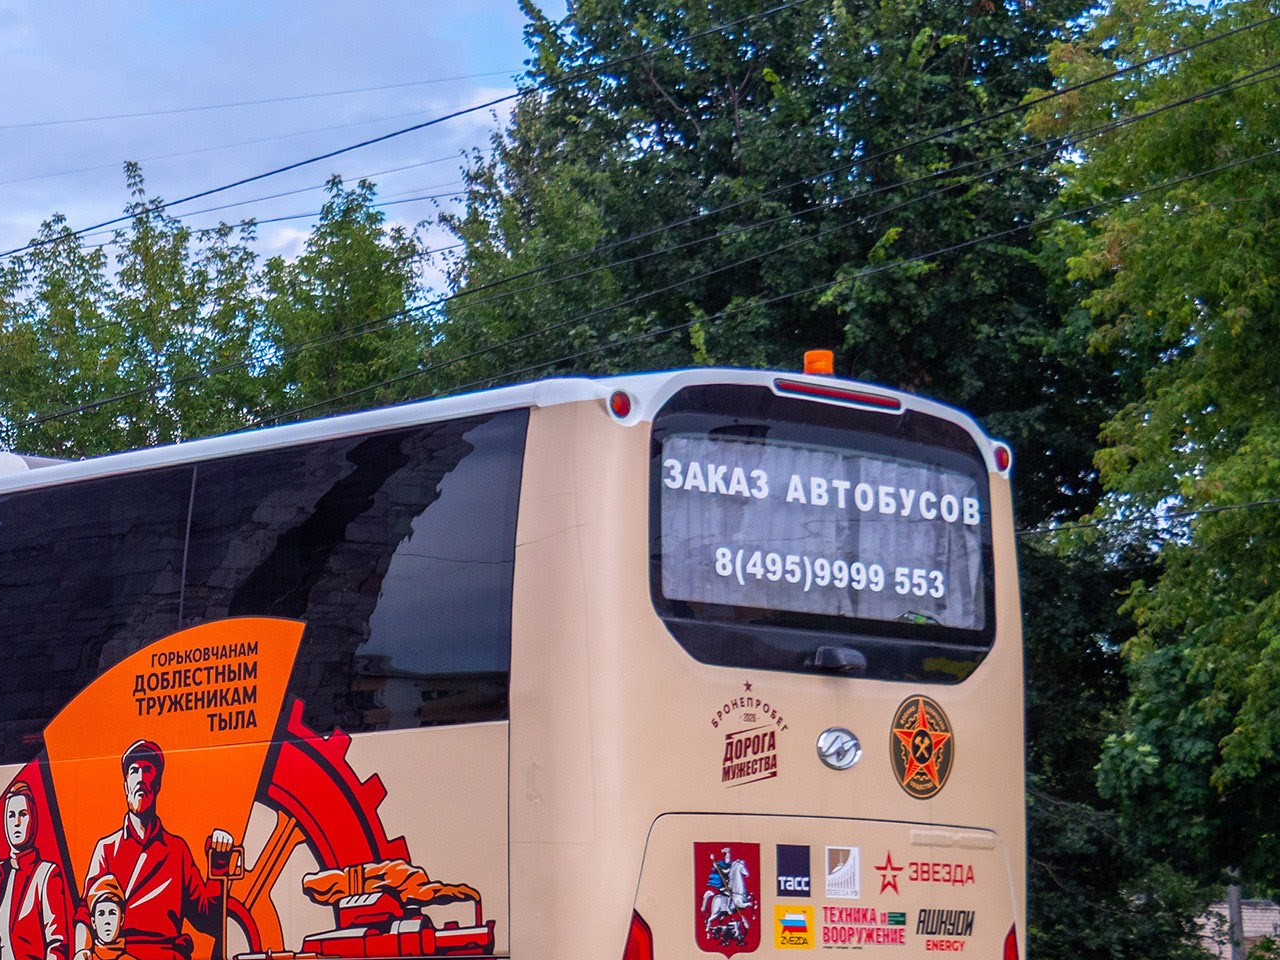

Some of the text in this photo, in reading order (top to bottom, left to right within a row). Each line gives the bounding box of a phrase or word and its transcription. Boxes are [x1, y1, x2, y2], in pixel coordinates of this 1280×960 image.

[663, 459, 981, 525] ЗАКАЗ АВТОБУСОВ
[715, 547, 945, 598] 8(495)9999 553
[151, 641, 258, 668] ГОРЬКОВЧАНАМ
[132, 661, 257, 697] ДОБЛЕСТНЫМ
[135, 685, 257, 716] ТРУЖЕНИКАМ
[711, 697, 788, 732] БРОНЕПРОБЕГ
[207, 709, 257, 732] ТЫЛА
[723, 730, 776, 766] ДОРОГА
[721, 753, 777, 783] МУЖЕСТВА
[909, 862, 975, 887] ЗВЕЗДА
[822, 906, 877, 926] ТЕХНИКА
[823, 926, 906, 946] ВООРУЖЕНИЕ
[926, 940, 965, 952] ENERGY
